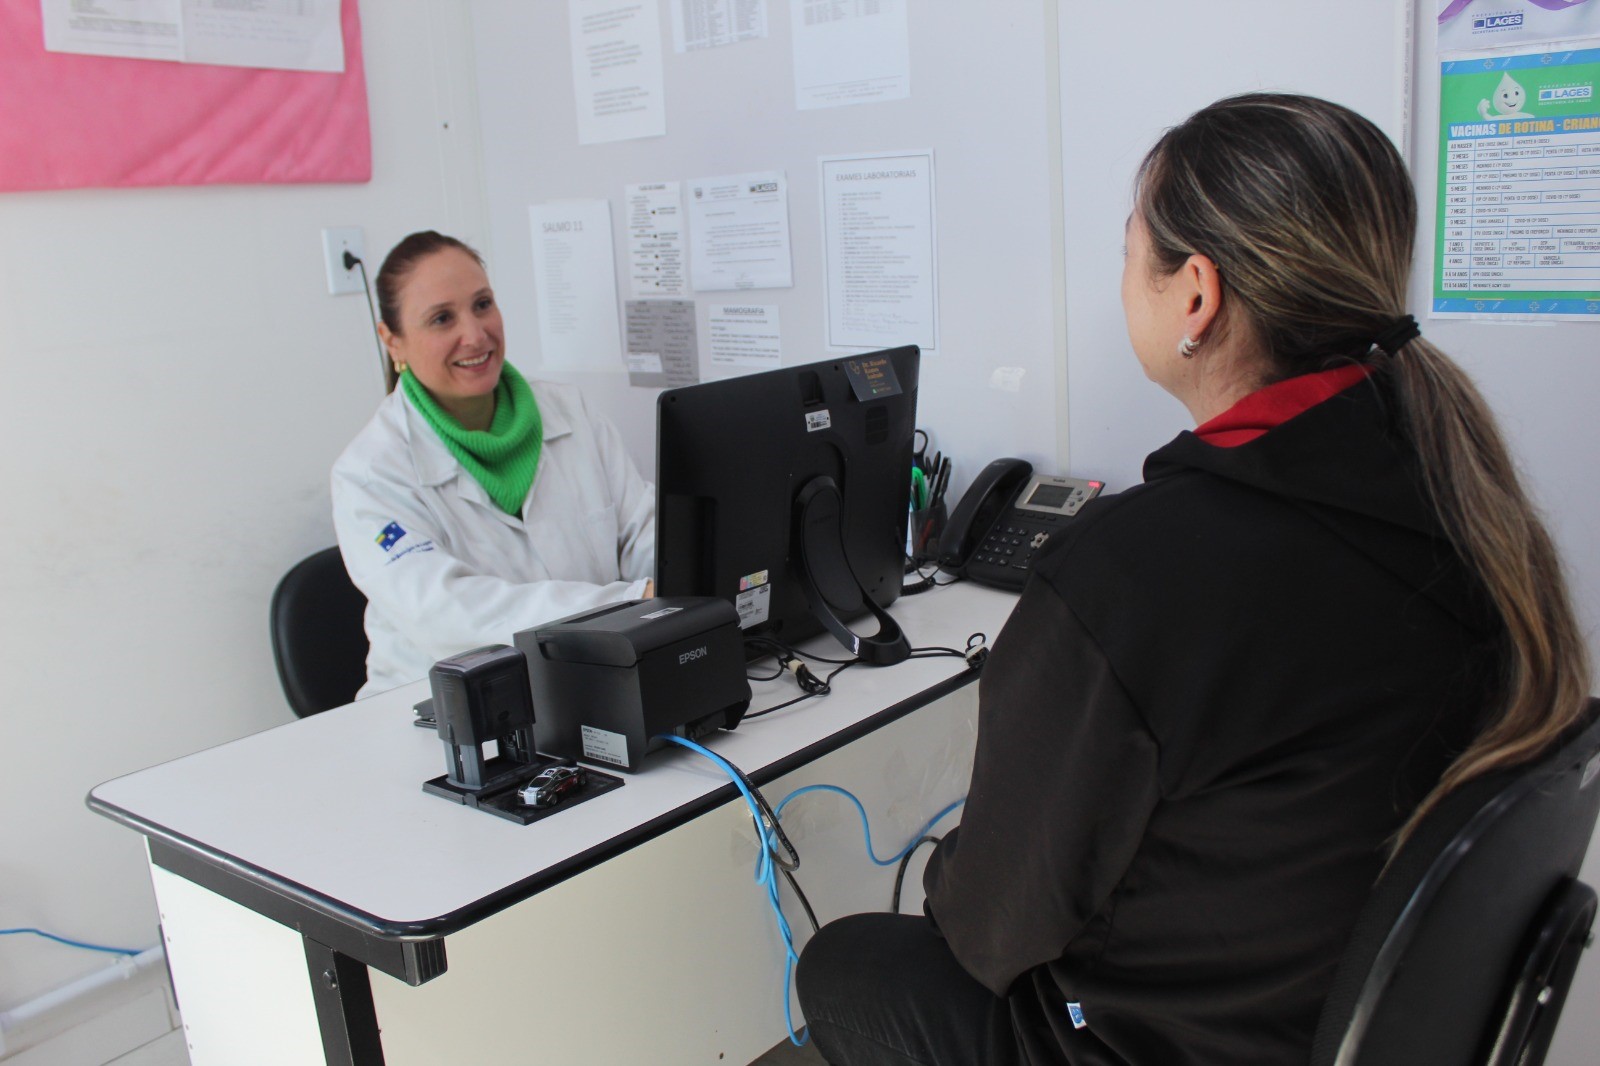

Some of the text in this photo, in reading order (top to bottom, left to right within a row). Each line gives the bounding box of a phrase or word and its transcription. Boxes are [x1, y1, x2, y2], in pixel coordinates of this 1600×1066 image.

[1486, 16, 1522, 27] LAGES
[1554, 88, 1590, 98] LAGES
[1450, 124, 1496, 137] VACINAS
[1498, 122, 1511, 134] DE
[1514, 120, 1555, 134] ROTINA
[836, 170, 916, 181] EXAMES LABORATORIAIS
[542, 220, 583, 232] SALMO 11
[679, 646, 707, 664] EPSON
